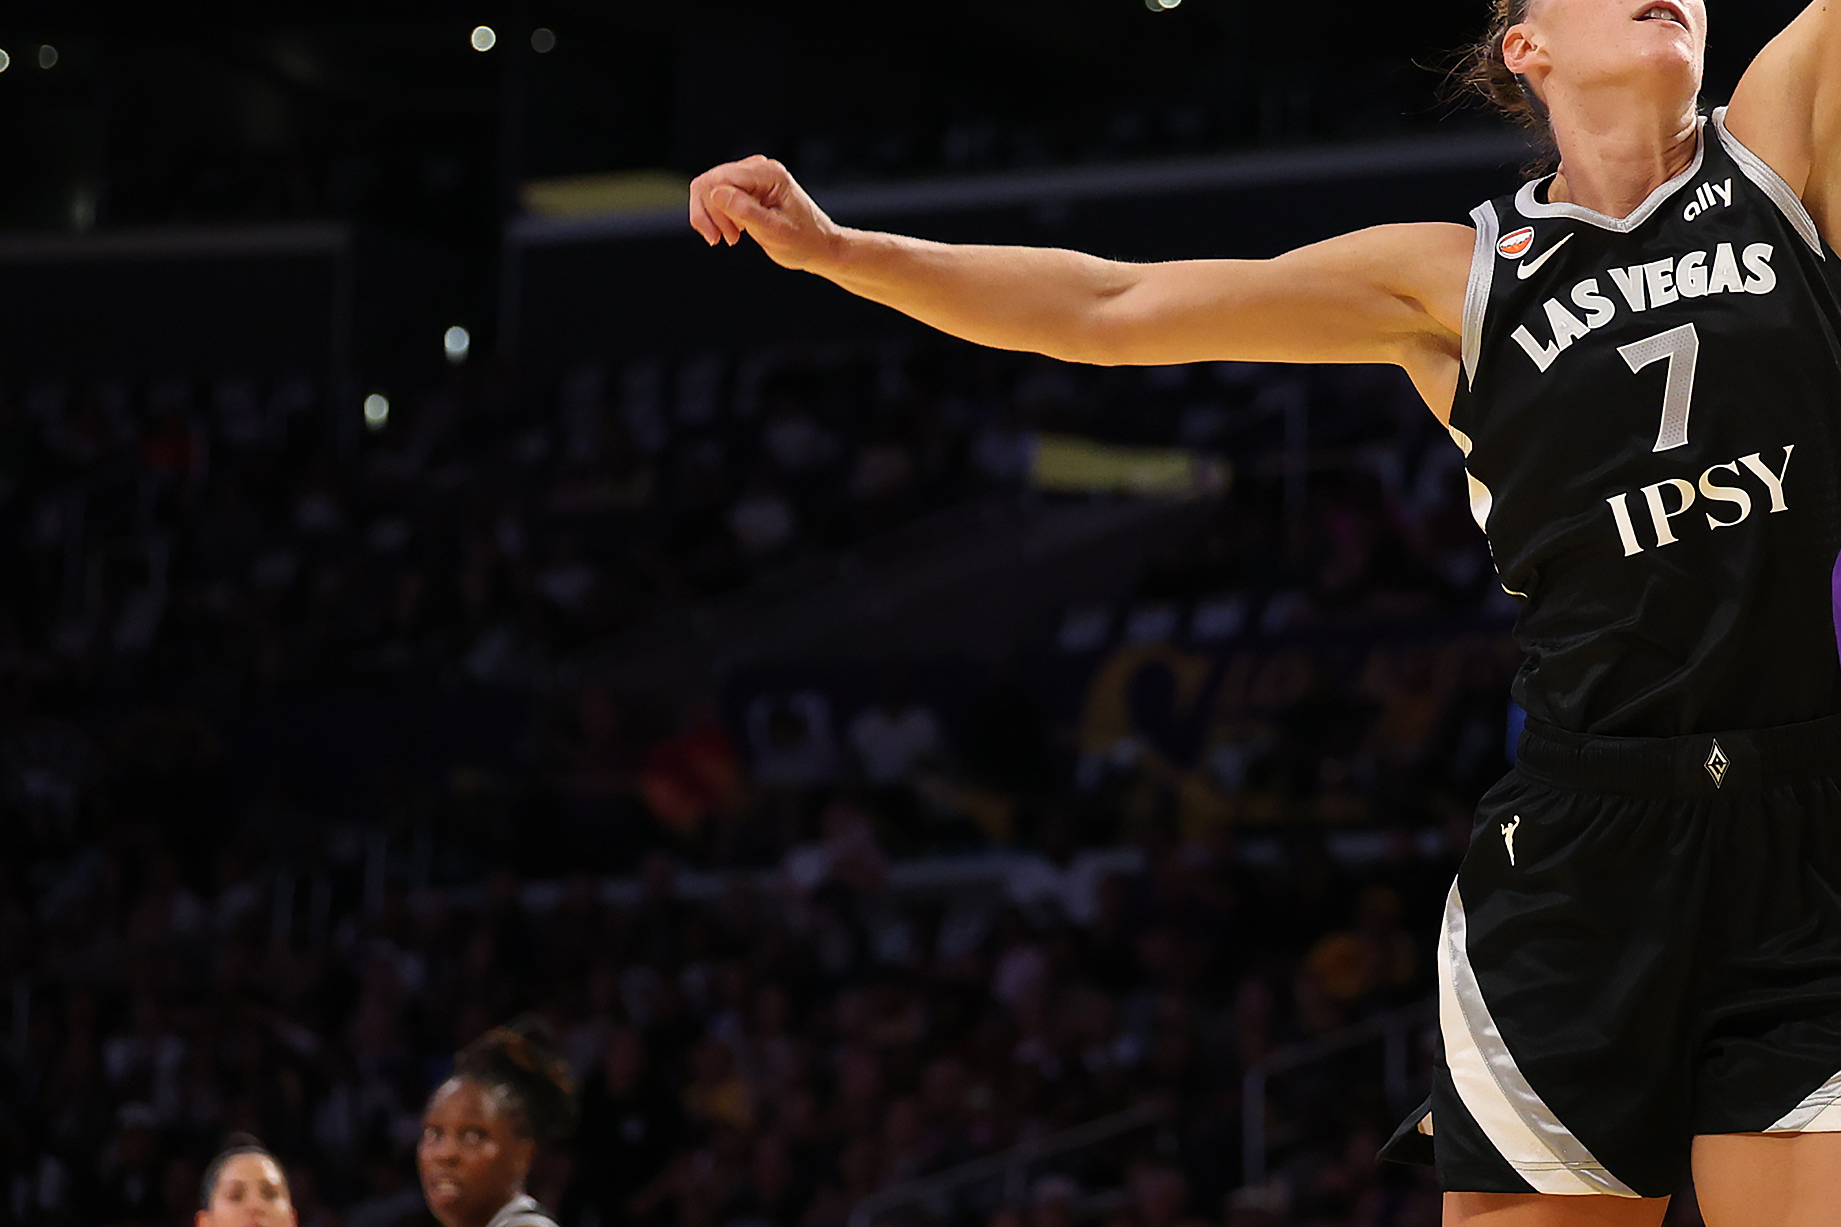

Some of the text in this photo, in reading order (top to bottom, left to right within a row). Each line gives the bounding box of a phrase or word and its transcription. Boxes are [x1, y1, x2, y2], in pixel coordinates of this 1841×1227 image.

[1683, 177, 1734, 223] ally
[1511, 242, 1778, 373] LAS VEGAS
[1616, 322, 1700, 454] 7
[1605, 444, 1796, 558] IPSY
